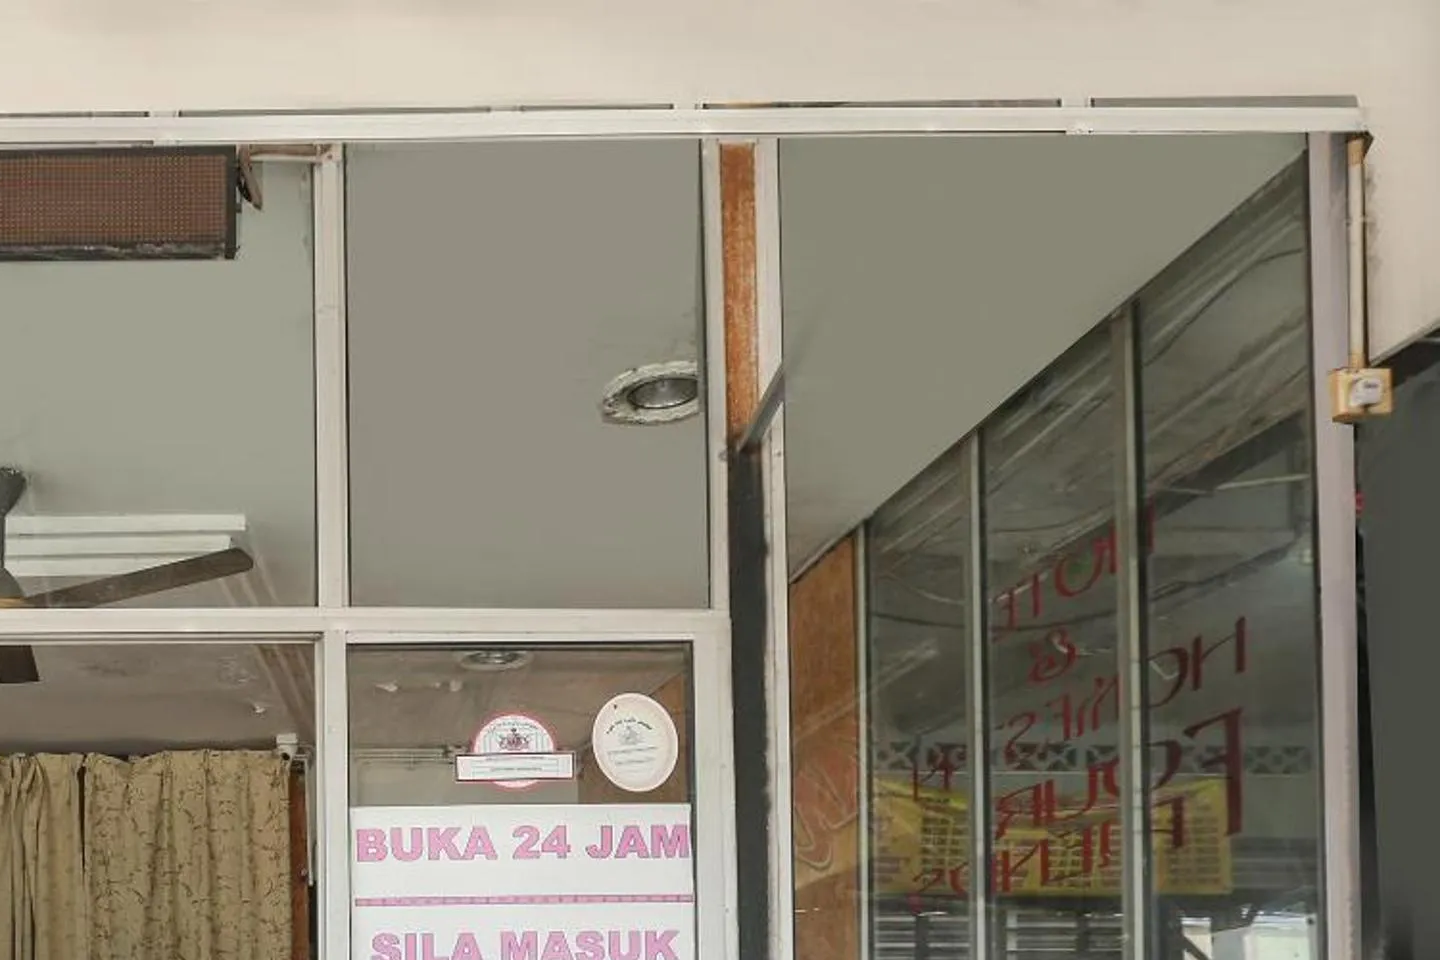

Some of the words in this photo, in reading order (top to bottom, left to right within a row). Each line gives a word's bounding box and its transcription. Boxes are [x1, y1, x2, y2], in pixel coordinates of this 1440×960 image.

[355, 826, 499, 862] BUKA
[511, 825, 572, 859] 24
[585, 823, 691, 859] JAM
